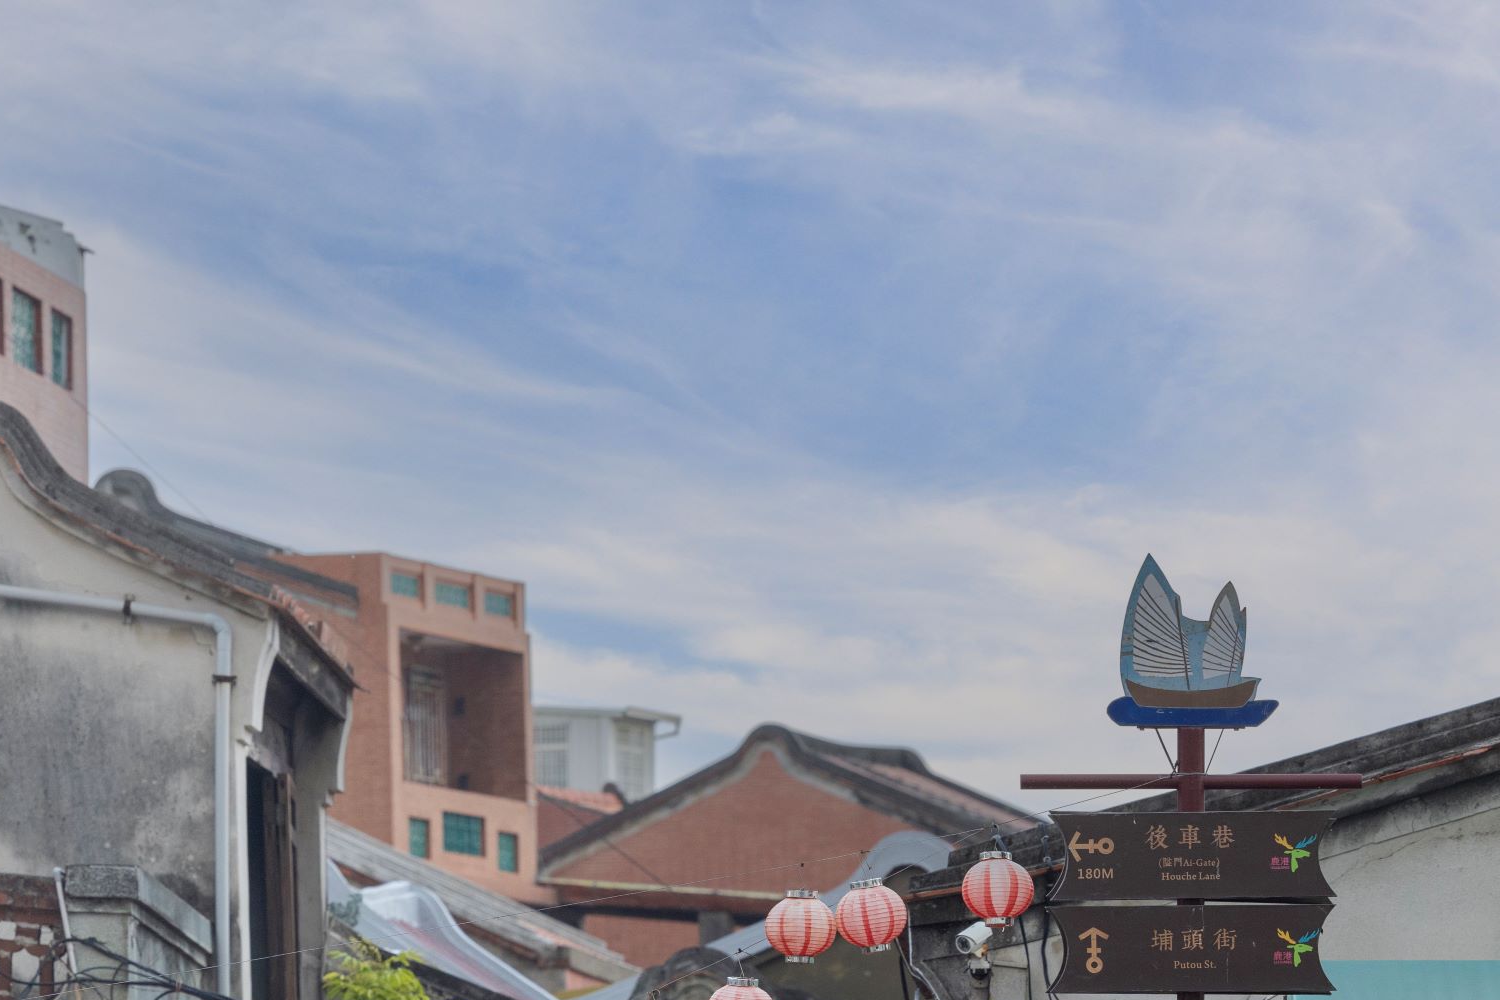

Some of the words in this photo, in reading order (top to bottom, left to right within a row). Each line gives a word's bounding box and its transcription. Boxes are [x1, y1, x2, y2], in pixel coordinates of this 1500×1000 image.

[1145, 824, 1236, 850] 後車巷
[1077, 867, 1114, 880] 180M
[1161, 871, 1197, 881] Houche
[1198, 871, 1221, 881] Lane
[1151, 928, 1237, 952] 埔頭街
[1173, 960, 1202, 970] Putou
[1204, 960, 1217, 970] St.
